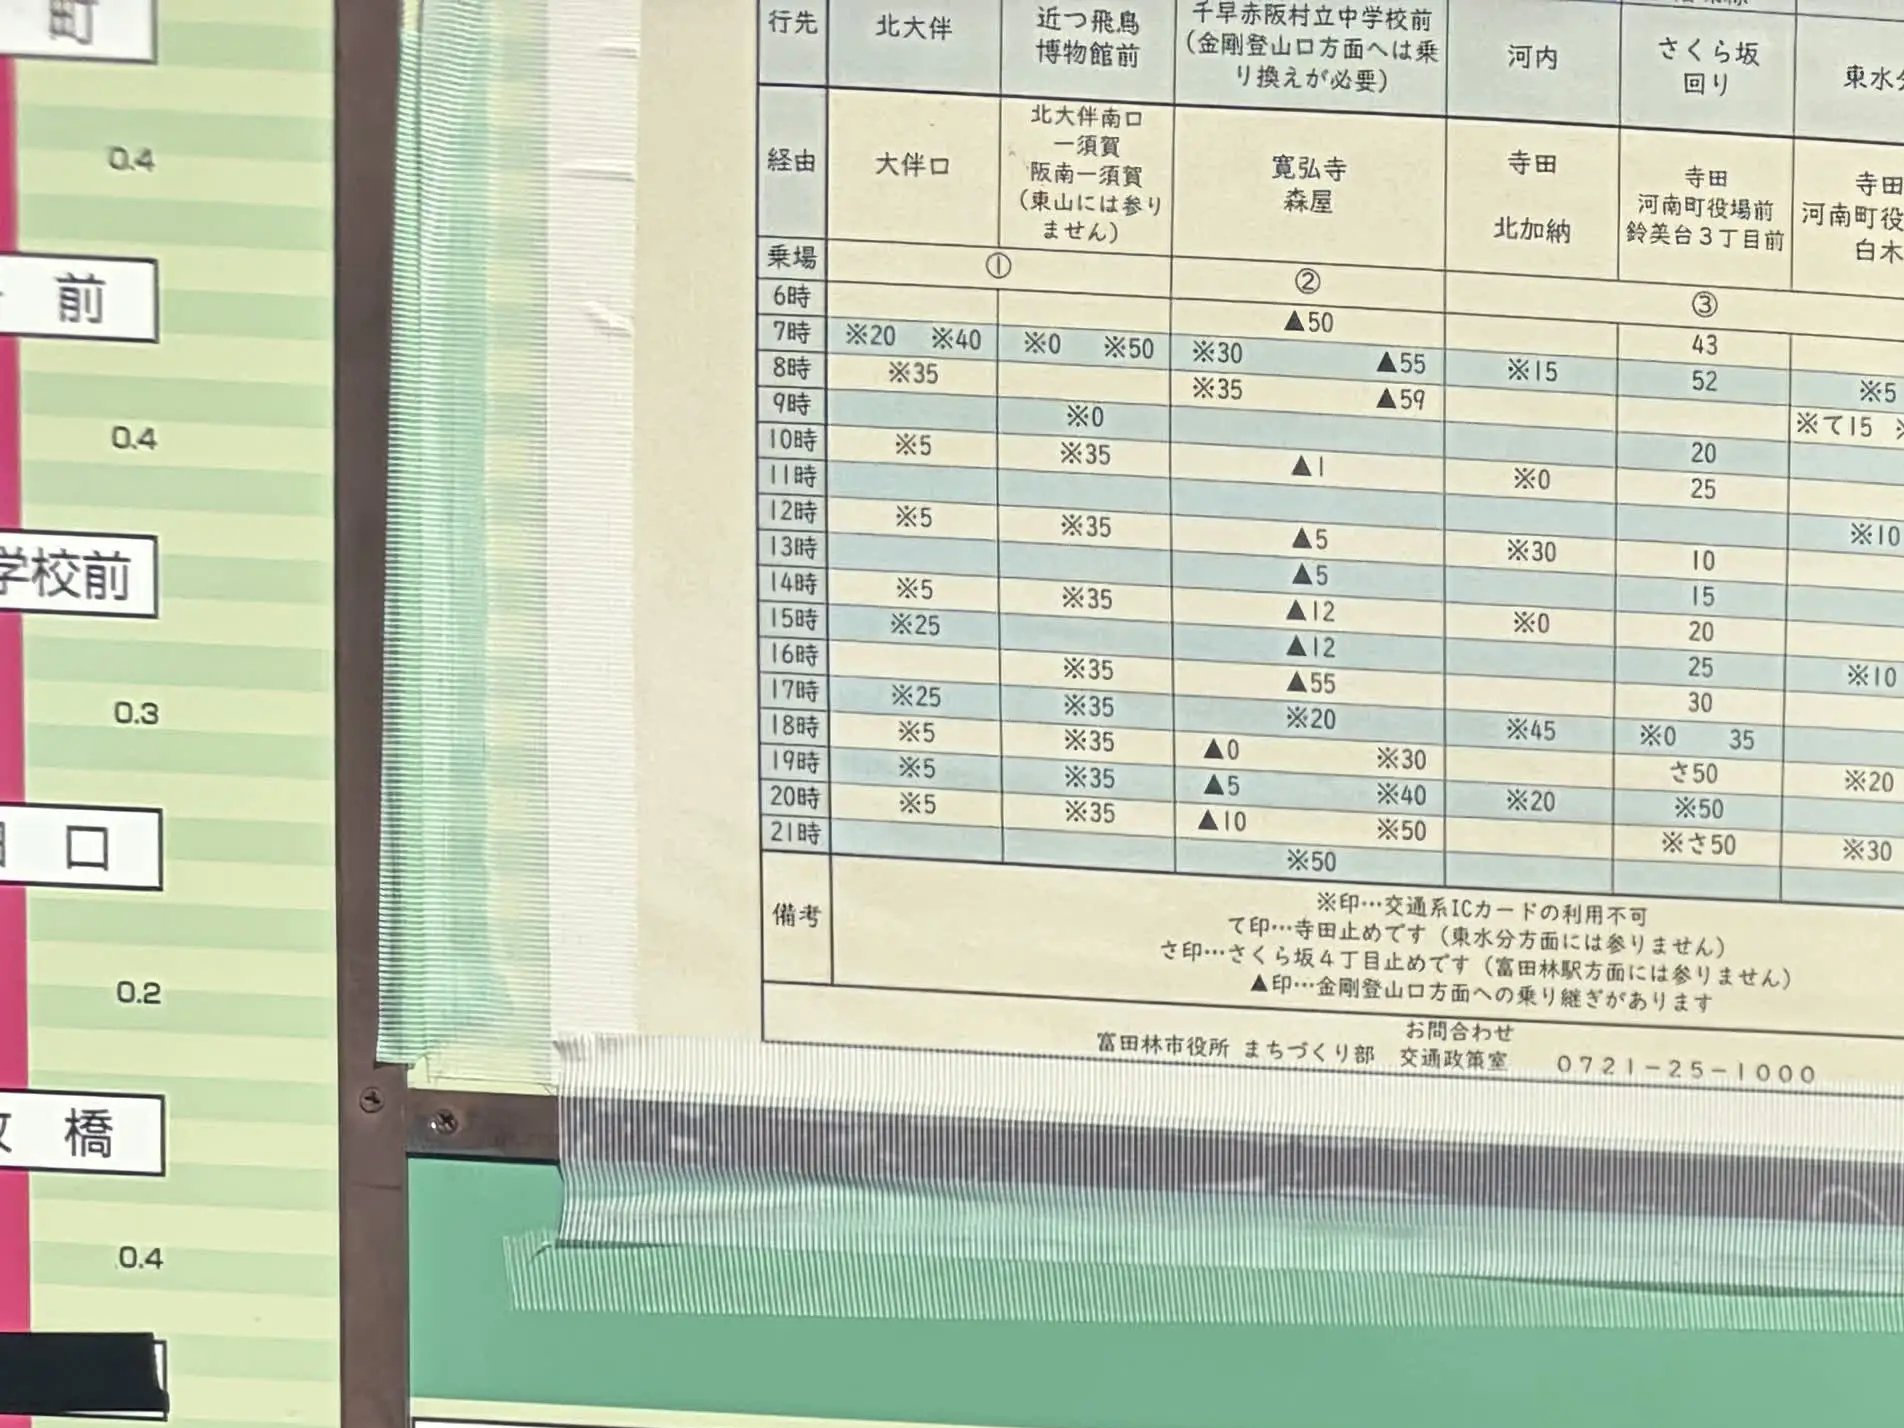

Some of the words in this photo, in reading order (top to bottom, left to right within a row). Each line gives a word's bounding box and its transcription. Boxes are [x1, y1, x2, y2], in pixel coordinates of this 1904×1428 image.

[768, 9, 819, 35] 行先
[875, 12, 953, 41] 北大伴
[1036, 5, 1140, 37] 近つ飛鳥
[1187, 0, 1433, 37] 千早赤阪村立中学校前
[1035, 38, 1141, 69] 博物館前
[1507, 43, 1558, 71] 河内
[1658, 36, 1760, 67] さくら坂
[1683, 72, 1728, 97] 回り
[1030, 103, 1142, 129] 北大伴南口
[108, 146, 156, 172] 0.4
[767, 146, 816, 173] 経由
[1053, 134, 1121, 159] 一須賀
[875, 151, 950, 178] 大伴口
[1030, 160, 1143, 189] 阪南一須賀
[1271, 153, 1348, 183] 寛弘寺
[1507, 148, 1557, 176] 寺田
[1684, 164, 1728, 189] 寺田
[1855, 170, 1904, 197] 寺田
[1019, 188, 1161, 217] （東山には参り
[1283, 187, 1334, 214] 森屋
[1638, 192, 1774, 222] 河南町役場前
[1043, 219, 1119, 245] ません）
[1493, 215, 1571, 245] 北加納
[767, 243, 819, 270] 乗場
[1855, 237, 1904, 265] 白木
[773, 283, 812, 309] 6時
[773, 320, 812, 345] 7時
[1691, 333, 1718, 356] 43
[772, 355, 812, 381] 8時
[1692, 369, 1718, 392] 52
[772, 391, 812, 417] 9時
[111, 425, 158, 451] 0.4
[770, 427, 819, 453] 10時
[1690, 440, 1717, 464] 20
[771, 463, 818, 489] 11時
[1690, 477, 1717, 500] 25
[771, 499, 819, 525] 12時
[771, 535, 818, 561] 13時
[1693, 549, 1716, 572] 10
[771, 571, 818, 596] 14時
[1693, 585, 1715, 608] 15
[771, 607, 819, 632] 15時
[1688, 620, 1715, 643] 20
[772, 642, 819, 668] 16時
[1687, 655, 1714, 679] 25
[772, 677, 820, 704] 17時
[1688, 690, 1713, 713] 30
[113, 700, 159, 726] 0.3
[772, 713, 820, 739] 18時
[1728, 728, 1755, 751] 35
[773, 749, 821, 775] 19時
[1669, 760, 1718, 785] さ50
[770, 784, 822, 811] 20時
[770, 820, 822, 846] 21時
[771, 902, 822, 929] 備考
[116, 980, 162, 1005] 0.2
[1405, 1019, 1515, 1044] お問合わせ
[1097, 1030, 1230, 1060] 富田林市役所
[1243, 1036, 1375, 1067] まちづくり部
[1399, 1045, 1510, 1073] 交通政策室
[118, 1245, 164, 1270] 0.4
